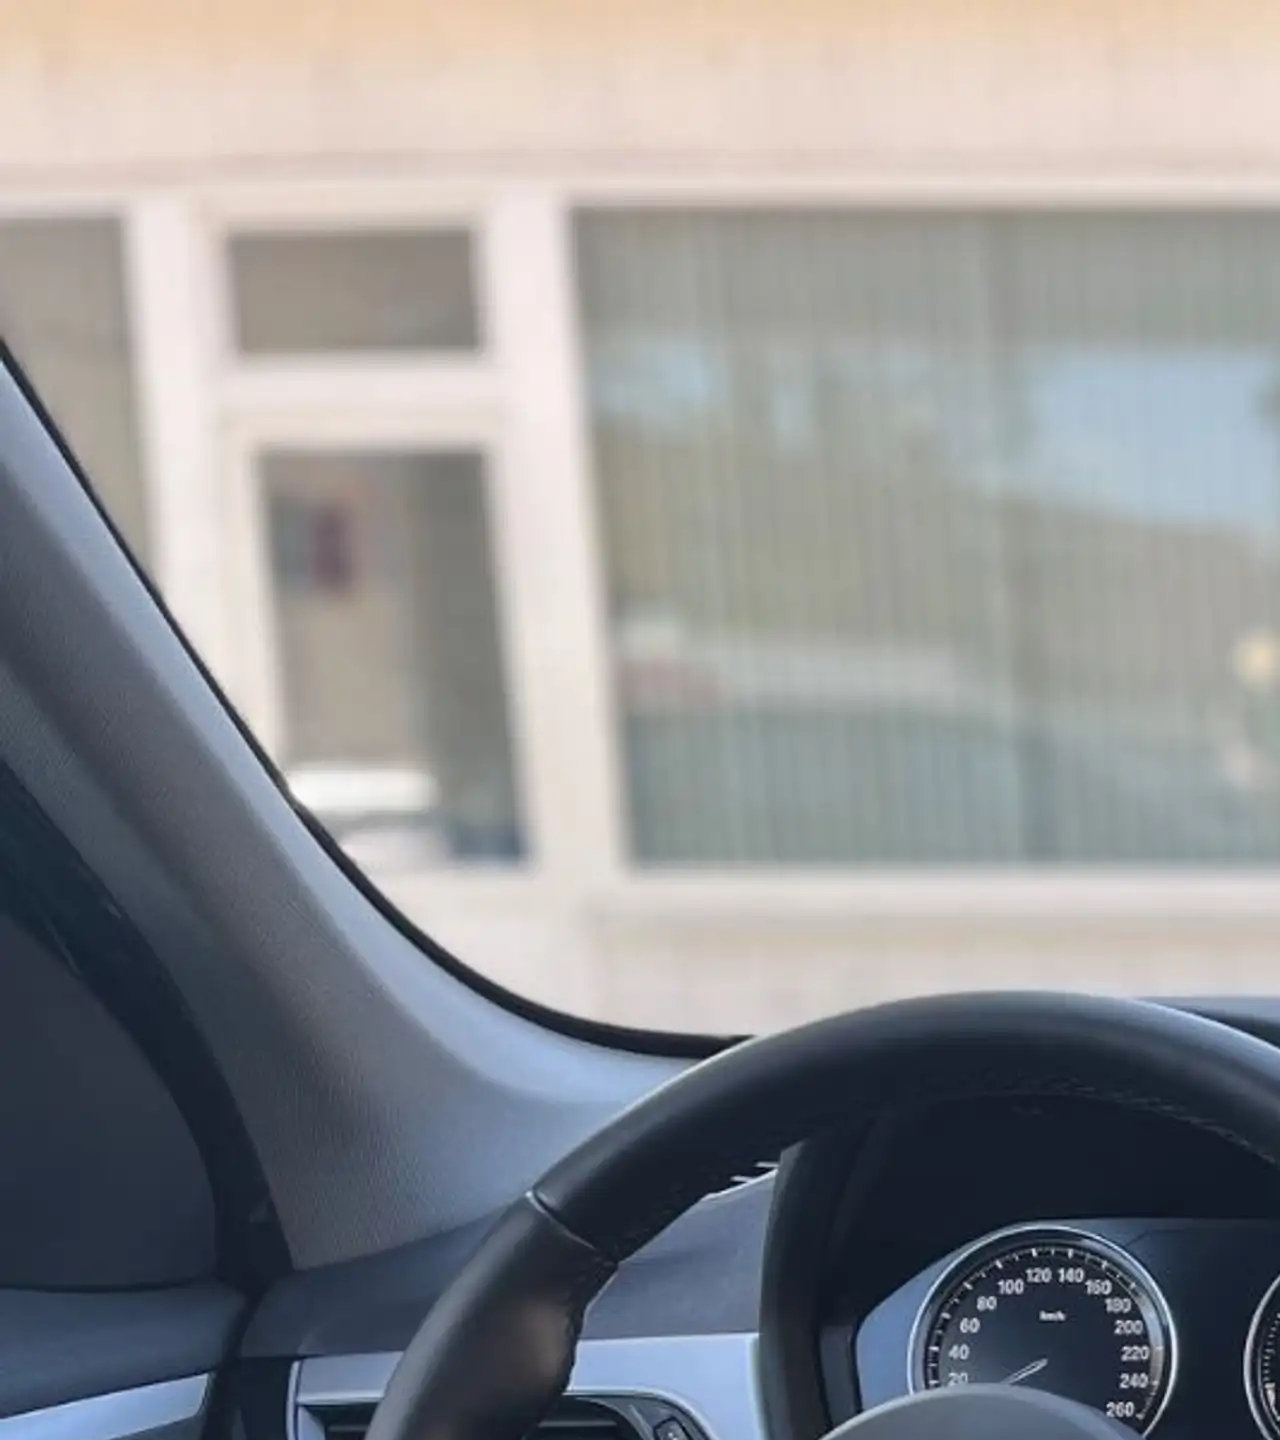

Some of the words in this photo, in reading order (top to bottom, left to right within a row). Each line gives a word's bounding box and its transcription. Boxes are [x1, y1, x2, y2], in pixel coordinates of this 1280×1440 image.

[1026, 1267, 1052, 1283] 120
[1058, 1267, 1084, 1283] 140
[998, 1279, 1024, 1295] 100
[1085, 1279, 1112, 1295] 160
[977, 1296, 997, 1311] 80
[1105, 1297, 1132, 1314] 180
[960, 1317, 980, 1333] 60
[1114, 1319, 1143, 1335] 200
[949, 1344, 969, 1360] 40
[1121, 1346, 1150, 1361] 220
[949, 1372, 969, 1386] 20
[1119, 1372, 1149, 1389] 240
[1106, 1401, 1135, 1417] 260
